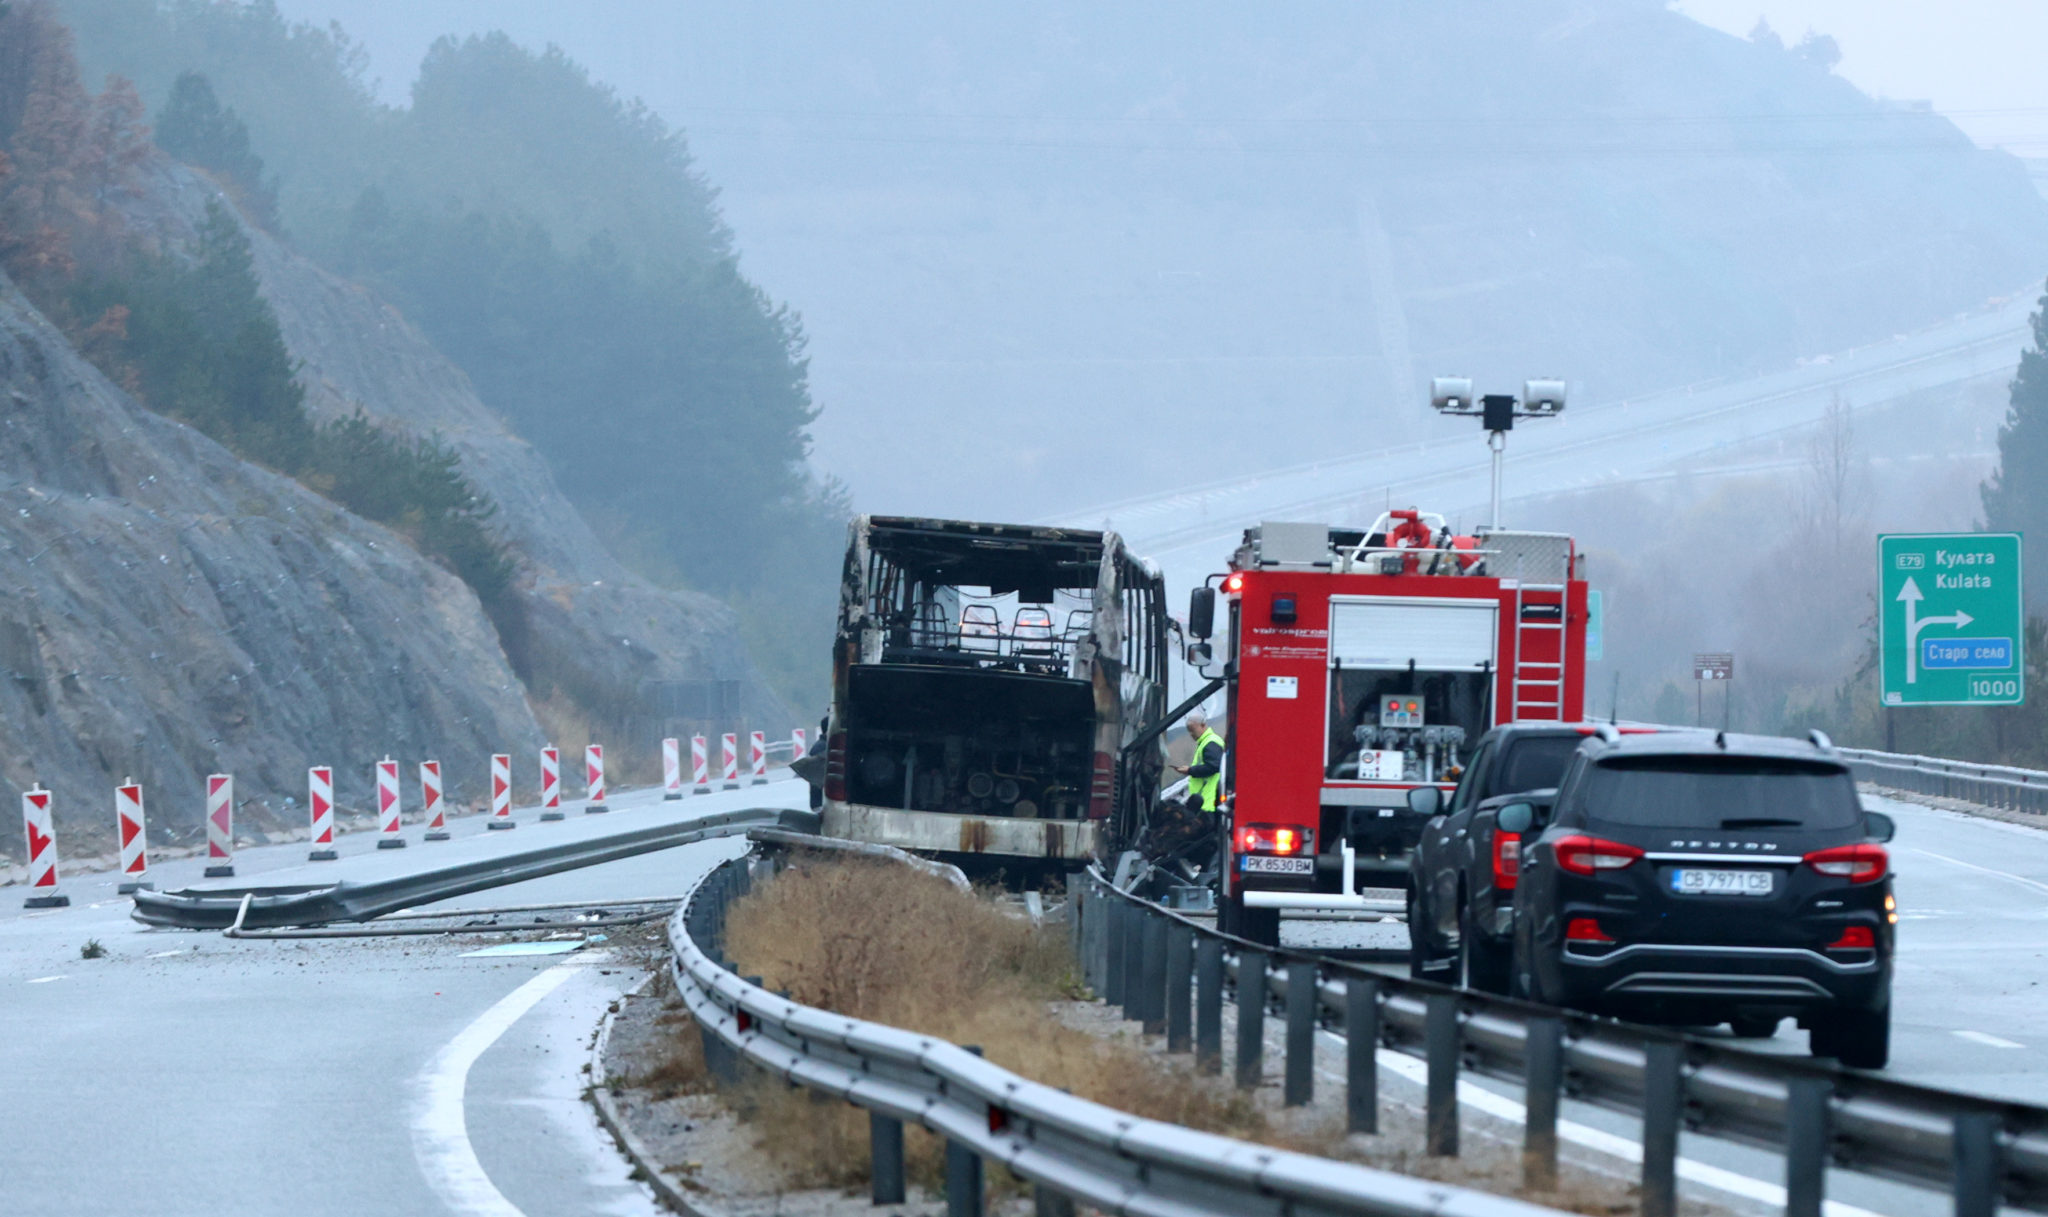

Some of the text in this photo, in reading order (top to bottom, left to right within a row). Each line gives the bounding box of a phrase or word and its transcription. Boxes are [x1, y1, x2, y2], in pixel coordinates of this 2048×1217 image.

[1899, 556, 1922, 567] E79
[1935, 550, 1995, 568] Кулата
[1935, 573, 1992, 589] Kulata
[1929, 644, 2005, 662] Старо село
[1972, 680, 2017, 696] 1000
[1248, 858, 1263, 869] PK
[1265, 859, 1294, 871] 8530
[1684, 872, 1770, 889] CB 7971 CB
